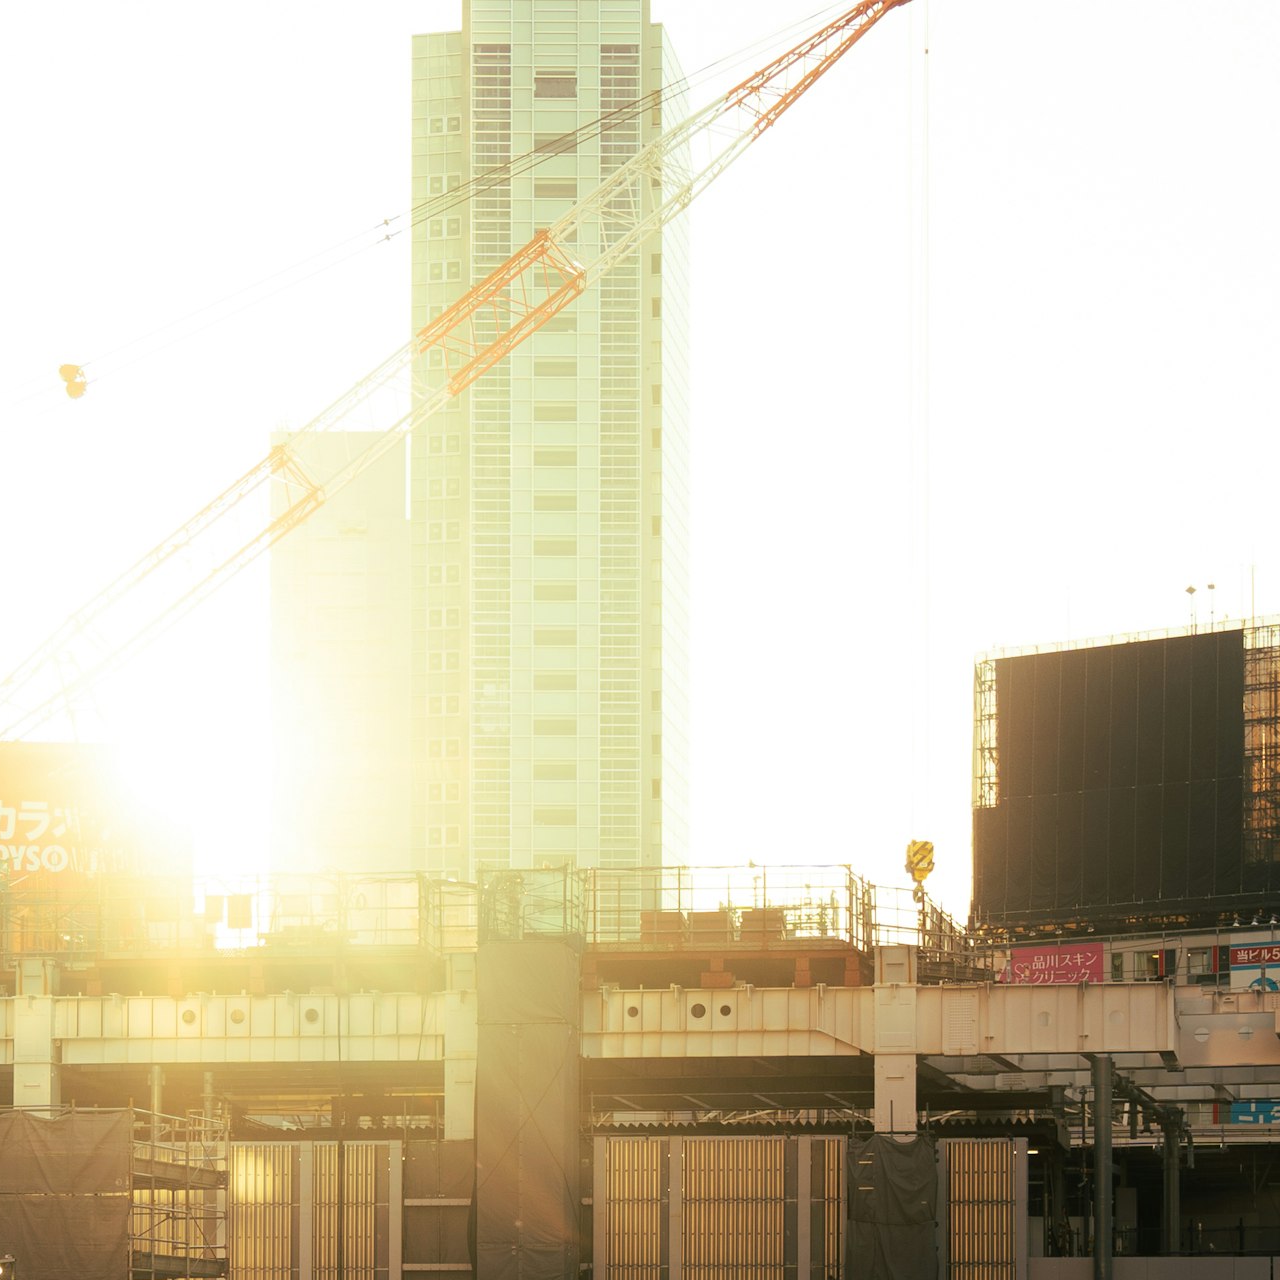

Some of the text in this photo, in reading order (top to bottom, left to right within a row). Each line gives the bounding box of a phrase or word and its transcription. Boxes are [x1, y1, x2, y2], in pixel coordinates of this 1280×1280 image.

[1032, 952, 1097, 970] 品川スキン
